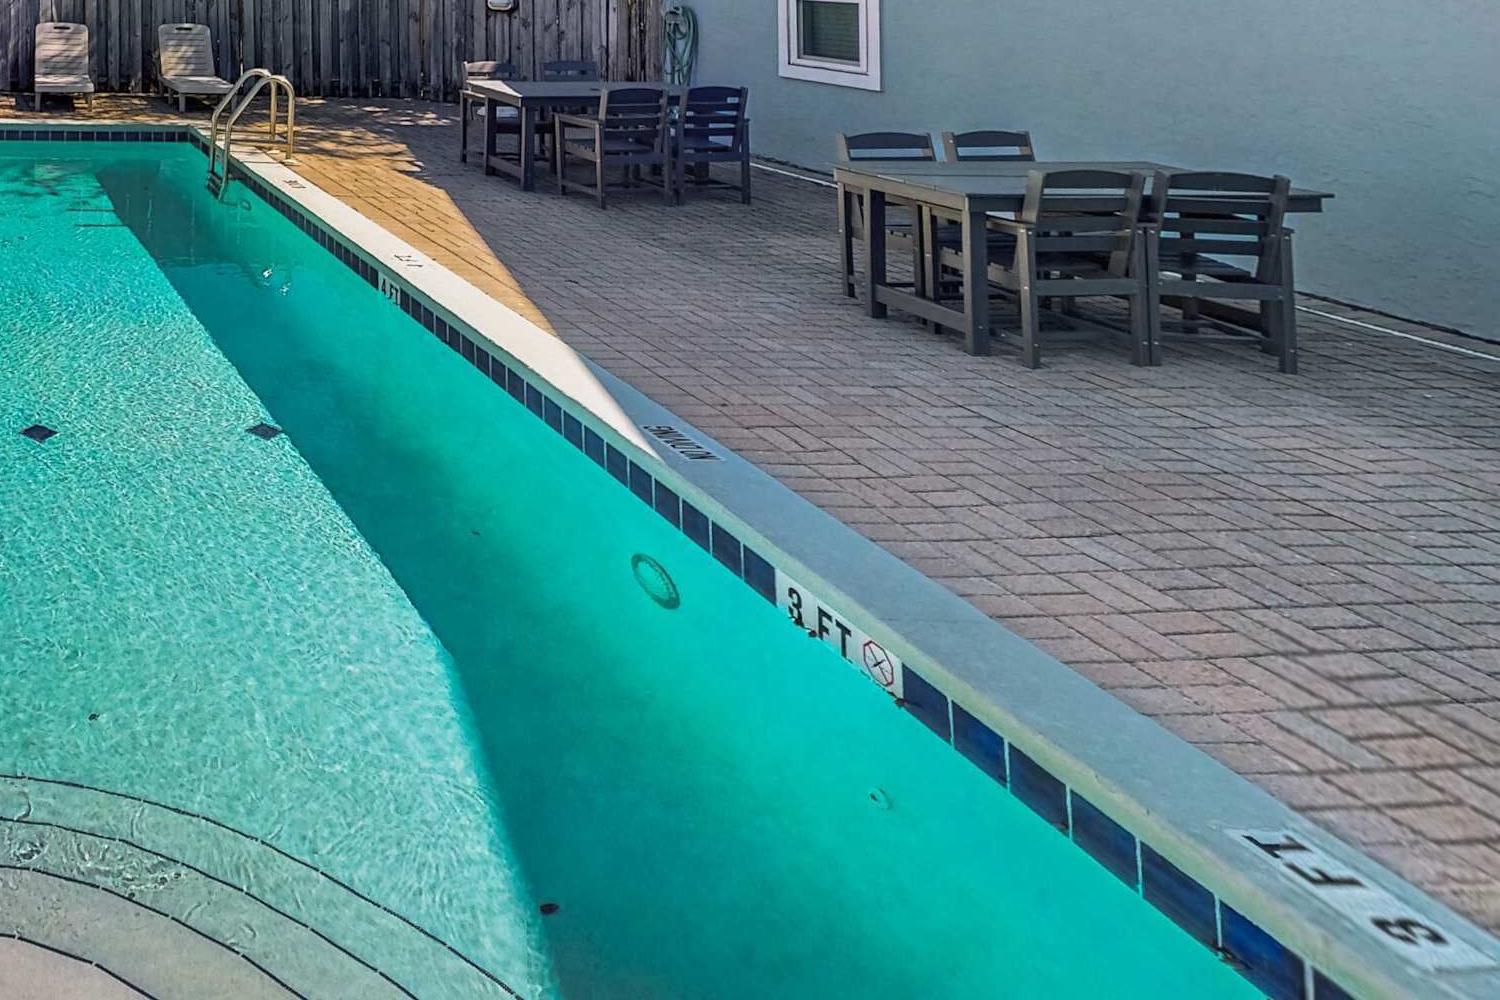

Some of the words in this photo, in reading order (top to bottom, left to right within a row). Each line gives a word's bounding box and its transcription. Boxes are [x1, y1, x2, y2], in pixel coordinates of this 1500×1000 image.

[381, 279, 387, 296] 4
[389, 283, 399, 306] FT
[787, 587, 804, 627] 3
[817, 605, 852, 659] FT
[1241, 834, 1368, 889] FT
[1369, 917, 1450, 946] 3
